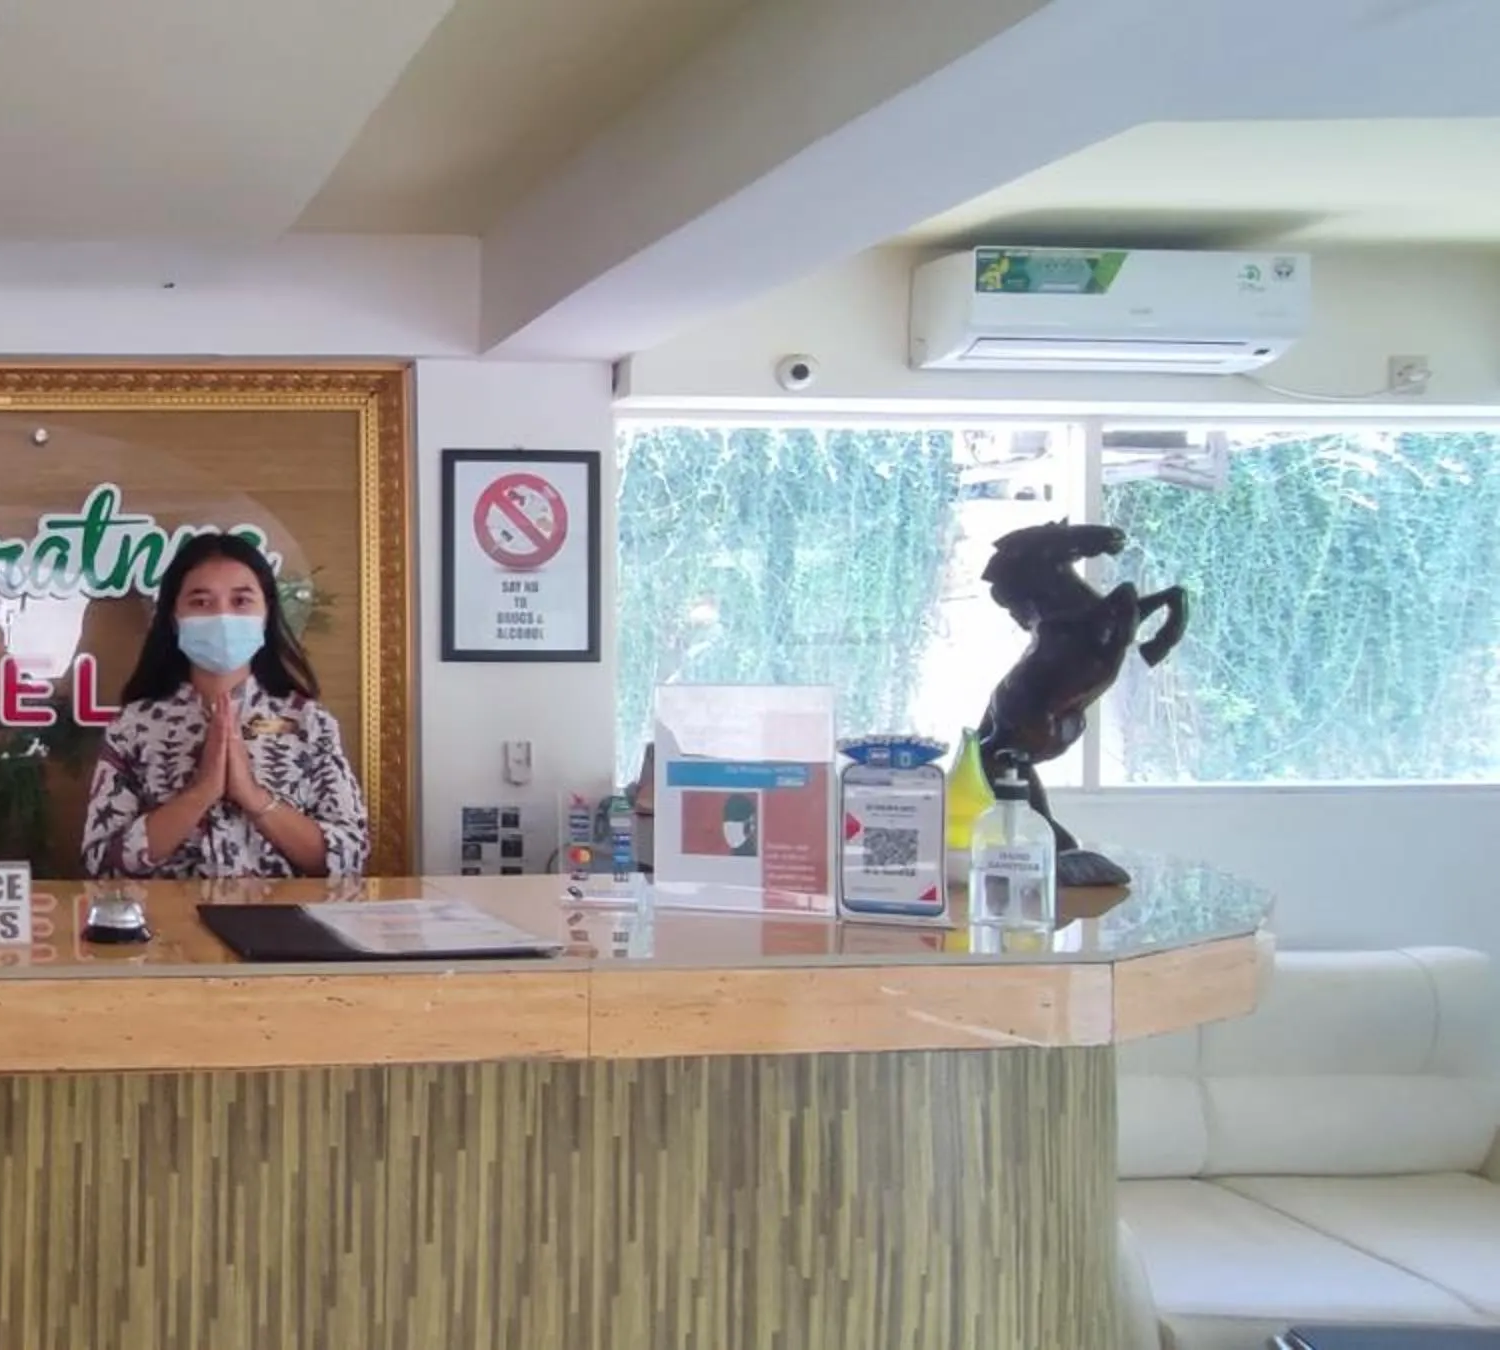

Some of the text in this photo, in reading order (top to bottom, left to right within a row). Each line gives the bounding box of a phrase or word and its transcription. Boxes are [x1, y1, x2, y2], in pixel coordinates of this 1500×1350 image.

[501, 580, 539, 593] SAY NO
[513, 596, 528, 609] TO
[496, 611, 534, 625] DRUGS
[496, 626, 545, 641] ALCOHOL
